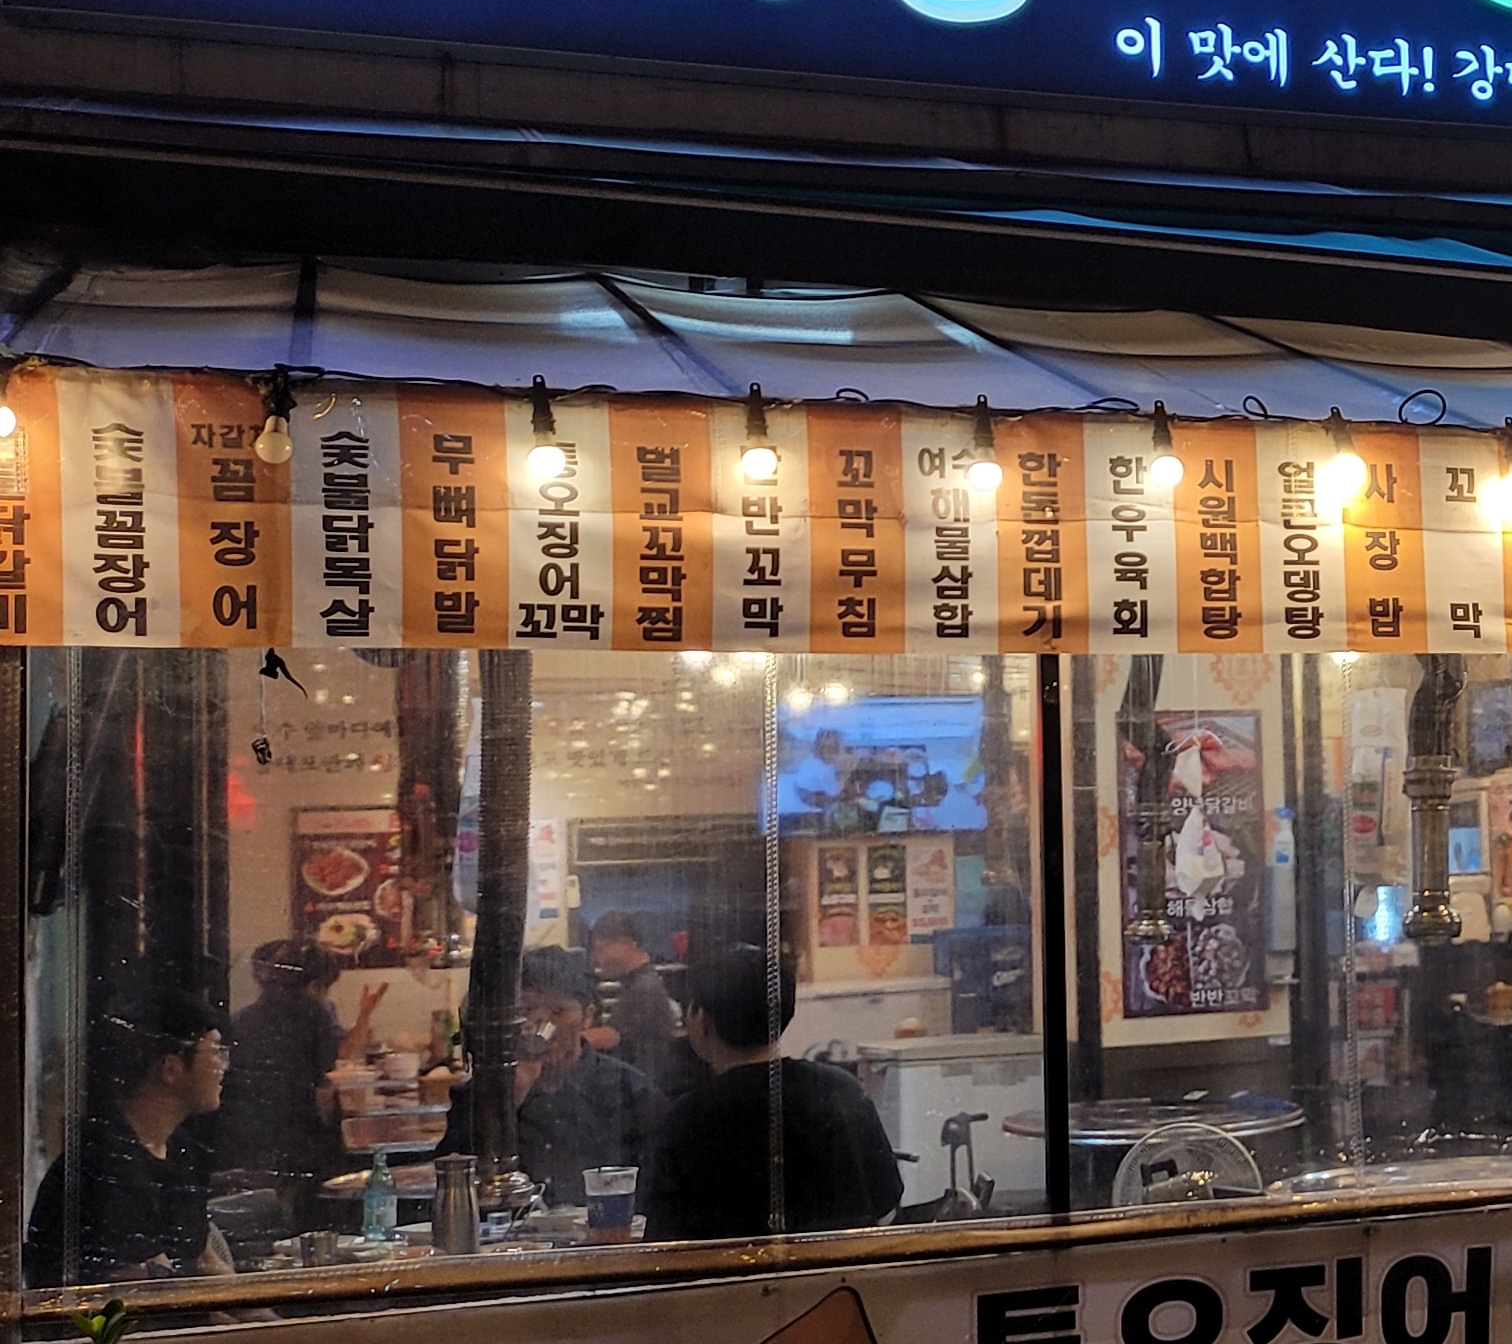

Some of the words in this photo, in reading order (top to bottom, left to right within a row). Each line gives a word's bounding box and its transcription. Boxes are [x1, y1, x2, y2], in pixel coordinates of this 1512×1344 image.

[1116, 17, 1161, 78] 이
[1188, 24, 1287, 87] 맛에
[1312, 34, 1434, 96] 산다!
[209, 458, 257, 629] 꼼장어
[320, 430, 375, 637] 숯불닭목살
[432, 434, 480, 633] 무뼈닭발
[515, 605, 604, 640] 꼬막
[635, 446, 687, 643] 벌교꼬막찜
[837, 448, 878, 638] 꼬막무침
[930, 488, 973, 638] 해물삼합
[1017, 451, 1063, 640] 한돈껍데기
[1109, 455, 1150, 638] 한우육회
[1198, 459, 1241, 640] 시원백합탕
